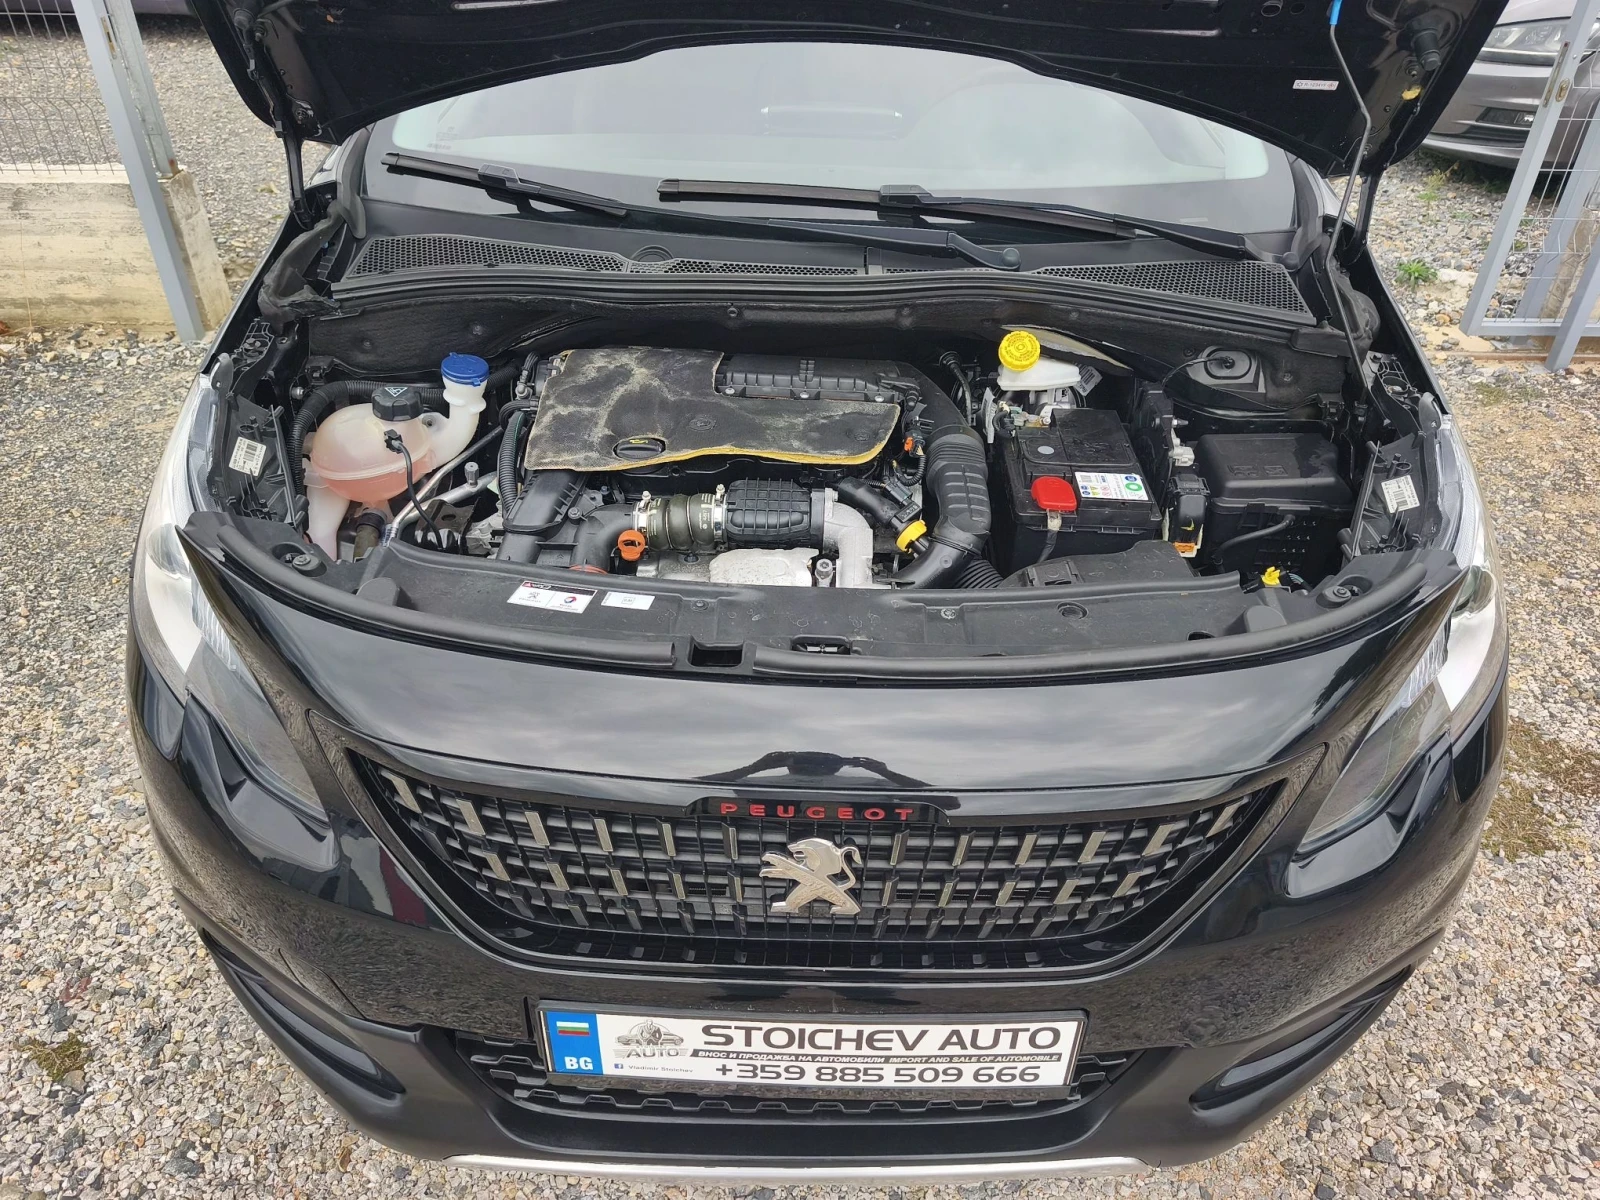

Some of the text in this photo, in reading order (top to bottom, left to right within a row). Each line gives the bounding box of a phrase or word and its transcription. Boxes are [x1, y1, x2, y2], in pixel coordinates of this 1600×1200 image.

[720, 802, 914, 821] PEUGEOT
[701, 1024, 1061, 1051] STOICHEV AUTO
[625, 1048, 680, 1058] AUTO
[698, 1051, 728, 1059] ВНОС
[729, 1052, 737, 1060] И
[738, 1053, 796, 1062] ПРОДАЖБА
[814, 1055, 886, 1064] АВТОМОБИЛИ
[564, 1056, 594, 1071] BG
[715, 1063, 1041, 1083] +359 885 509 666
